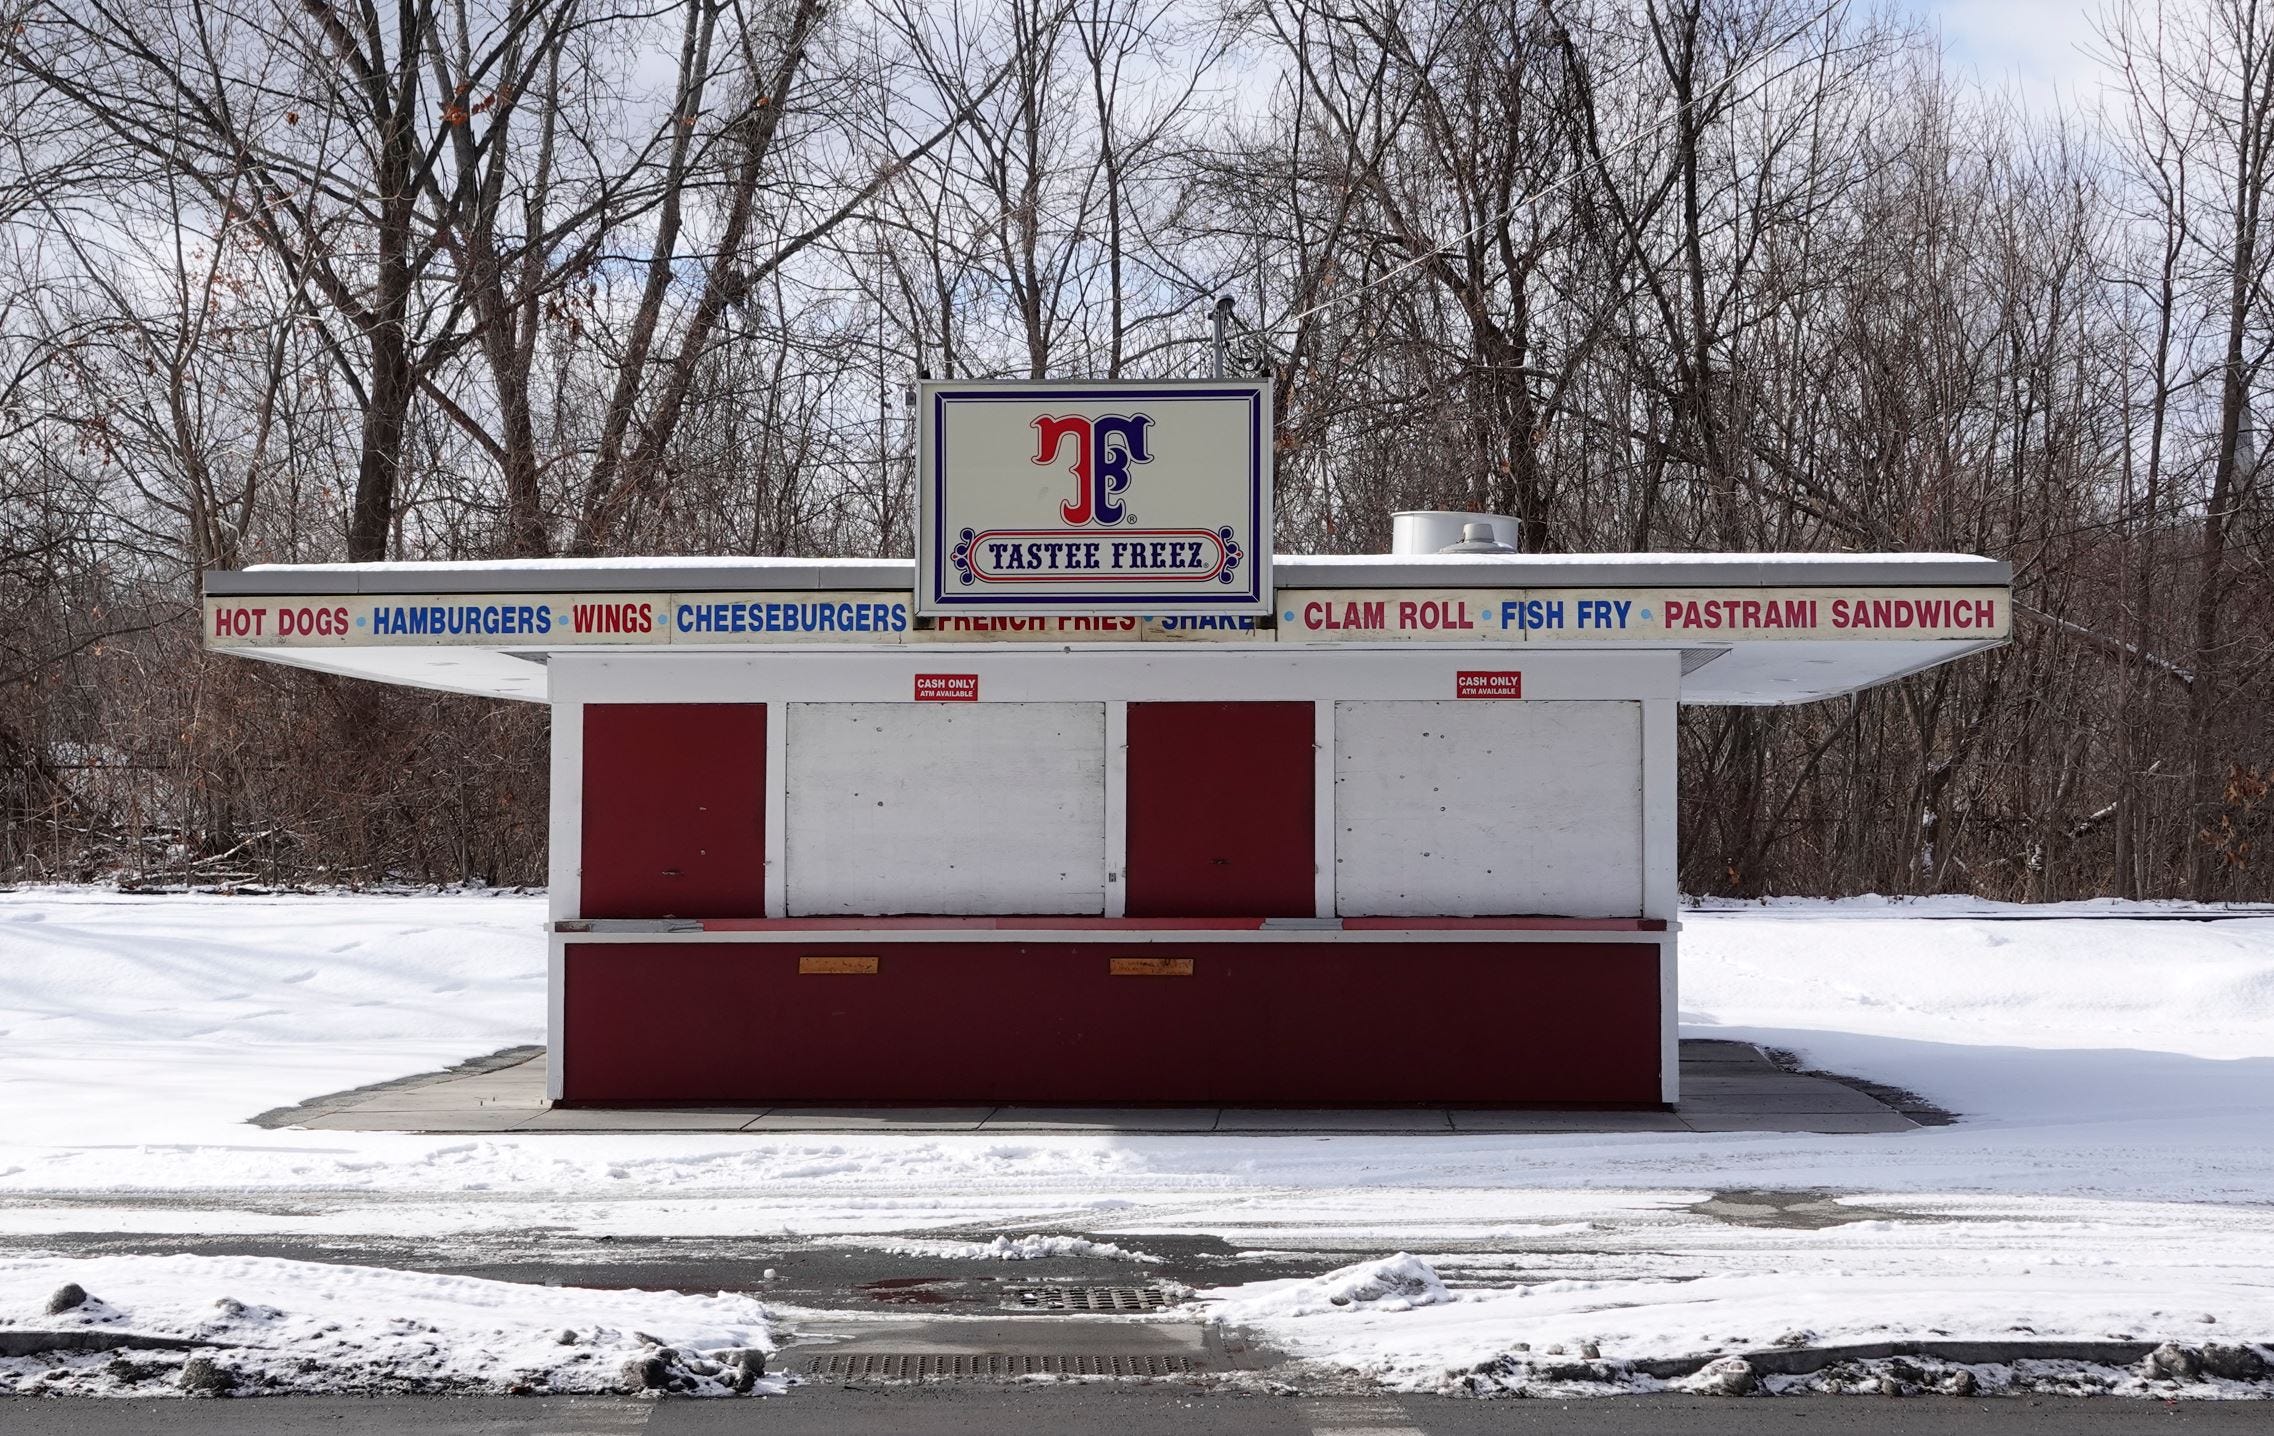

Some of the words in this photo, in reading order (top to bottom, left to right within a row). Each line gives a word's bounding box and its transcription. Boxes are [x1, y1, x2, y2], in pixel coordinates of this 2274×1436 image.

[988, 543, 1100, 570] TASTEE
[1111, 542, 1203, 569] FREEZ
[215, 608, 267, 636] HOT
[278, 607, 349, 636] DOGS
[373, 605, 551, 634] HAMBURGERS
[573, 603, 652, 634] WINGS
[677, 603, 907, 633] CHEESEBURGERS
[1304, 602, 1386, 630] CLAM
[1399, 601, 1474, 630] ROLL
[1501, 601, 1564, 629] FISH
[1577, 600, 1631, 629] FRY
[1665, 600, 1817, 629] PASTRAMI
[1831, 599, 1994, 629] SANDWICH
[917, 679, 945, 689] CASH
[948, 679, 976, 689] ONLY
[1458, 676, 1487, 686] CASH
[1490, 676, 1518, 686] ONLY
